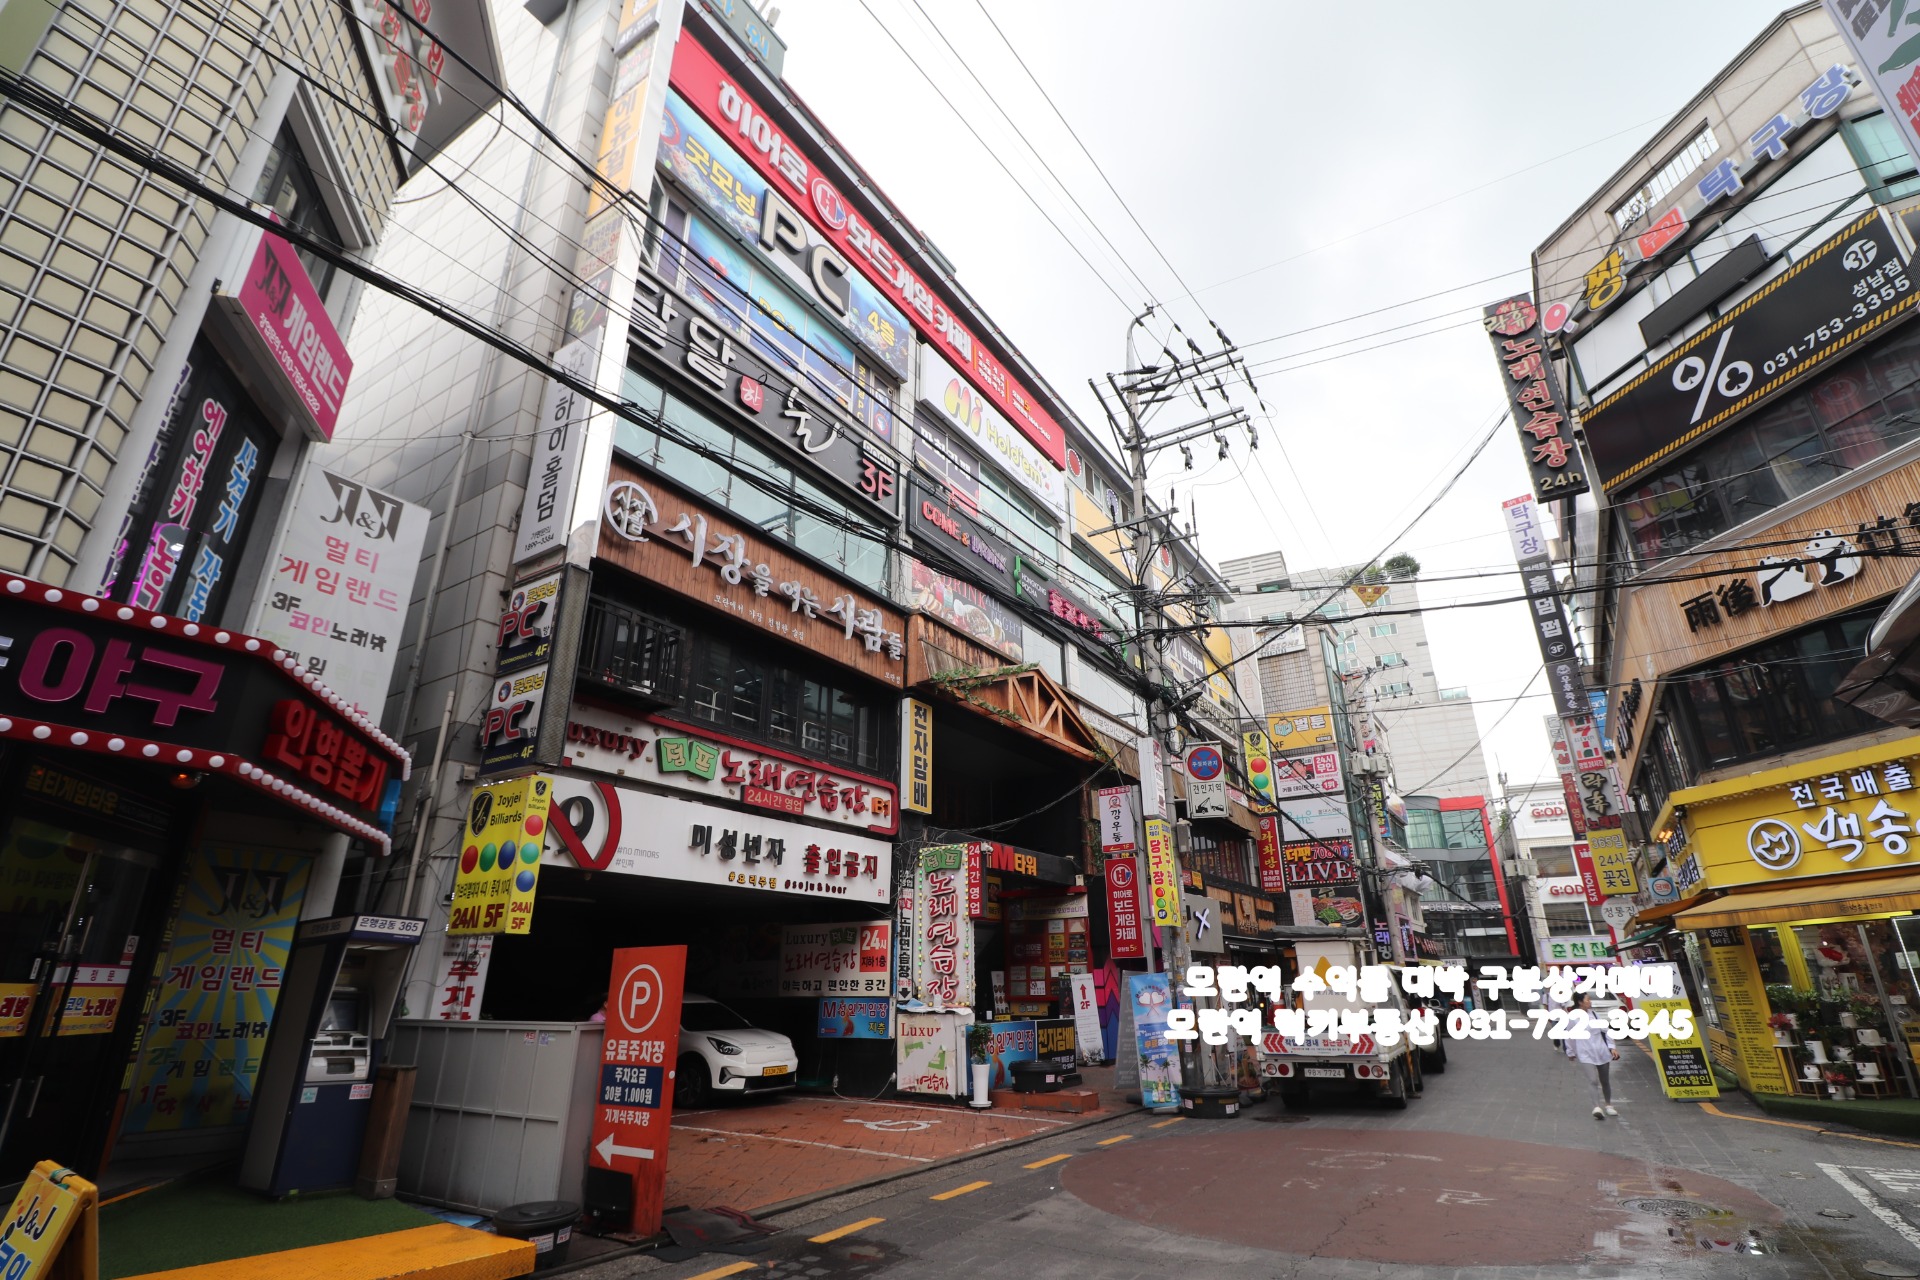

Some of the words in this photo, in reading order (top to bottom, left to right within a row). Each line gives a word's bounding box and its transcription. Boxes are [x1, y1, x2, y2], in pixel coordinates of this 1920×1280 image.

[1583, 248, 1628, 312] 짱
[1642, 213, 1687, 252] 무인
[1697, 63, 1853, 206] 탁구장
[719, 79, 808, 197] 히어로
[847, 213, 972, 364] 보드게임카페
[684, 135, 757, 216] 굿모닝
[758, 187, 850, 317] PC
[867, 310, 897, 348] 4층
[1843, 239, 1878, 272] 3F
[1851, 257, 1903, 299] 성남점
[1485, 300, 1537, 336] 락휴
[1763, 274, 1911, 376] 031-753-3355
[283, 292, 345, 415] 게임랜드
[1502, 337, 1573, 467] 노래연습장
[943, 377, 984, 437] Hi
[986, 418, 1043, 490] Hold'em
[168, 398, 228, 530] 에어하키
[212, 437, 258, 544] 사격기
[861, 458, 894, 500] 3F
[1539, 471, 1582, 491] 24h
[319, 470, 404, 543] J&J
[921, 501, 961, 541] COME
[1510, 504, 1540, 555] 탁구장
[324, 536, 380, 574] 멀티
[279, 556, 399, 613] 게임랜드
[526, 578, 559, 606] 굿모닝
[664, 512, 774, 597] 시장을
[779, 580, 821, 619] 여는
[825, 593, 904, 661] 사람들
[271, 592, 302, 613] 3F
[713, 594, 744, 614] 모란에서
[1529, 574, 1563, 639] 홀덤펍
[1680, 578, 1760, 634] 雨後
[496, 602, 548, 648] PC
[535, 642, 549, 657] 4F
[1550, 644, 1565, 655] 3F
[512, 670, 546, 697] 굿모닝
[482, 700, 535, 748] PC
[264, 702, 387, 812] 인형뽑기
[521, 745, 534, 759] 4F
[913, 704, 929, 808] 전자담배
[1274, 741, 1285, 749] 4F
[1192, 755, 1218, 768] 주정차금지
[1315, 754, 1333, 765] 24시
[1317, 763, 1336, 774] 무인
[722, 750, 871, 814] 노래연습장
[871, 796, 891, 818] B1
[1192, 783, 1223, 794] 견인지역
[1324, 781, 1335, 790] 1위
[1790, 763, 1916, 810] 전국매출
[497, 791, 521, 808] Joyjei
[747, 788, 782, 807] 24시간
[785, 796, 803, 813] 영업
[490, 811, 522, 828] Billiards
[1110, 809, 1123, 843] 깡우동
[1802, 799, 1920, 864] 백송
[690, 823, 786, 867] 미성년자
[804, 843, 879, 880] 출입금지
[1312, 844, 1341, 859] 7080
[1591, 834, 1624, 849] 365일
[1149, 839, 1164, 885] 당구장
[1290, 861, 1352, 882] LIVE
[1599, 853, 1625, 867] 24시
[728, 871, 777, 889] #요리주점
[1583, 872, 1598, 902] HOLLYS
[1602, 869, 1630, 888] 꽃집
[207, 866, 288, 918] J&J
[1113, 889, 1133, 899] 히어로
[483, 902, 505, 928] 5F
[1114, 900, 1134, 912] 보드
[360, 917, 398, 932] 은행공동
[398, 920, 419, 933] 365
[511, 917, 526, 930] 5F
[1115, 913, 1135, 926] 게임
[211, 928, 264, 955] 멀티
[785, 931, 828, 947] Luxury
[861, 929, 888, 951] 24시
[926, 873, 959, 1002] 노래연습장
[1116, 927, 1137, 940] 카페
[1374, 917, 1392, 960] 노래방
[1711, 928, 1729, 938] 365일
[784, 948, 857, 974] 노래연습장
[1551, 941, 1608, 958] 춘천집
[166, 964, 280, 993] 게임랜드
[782, 978, 823, 993] 아늑하고
[828, 978, 860, 993] 편안한
[865, 978, 886, 992] 공간
[85, 995, 117, 1017] 노래방
[630, 981, 651, 1019] P
[822, 1000, 888, 1020] M성인게임장
[1080, 1000, 1091, 1010] 2F
[1648, 1001, 1668, 1009] 나라를
[159, 1009, 186, 1027] 3F
[868, 1021, 886, 1034] 지층
[605, 1039, 665, 1064] 유료주차장
[1038, 1026, 1075, 1054] 전자담배
[615, 1066, 647, 1085] 주차요금
[1323, 1069, 1342, 1077] 7724
[1668, 1075, 1711, 1087] 30%할인
[605, 1085, 621, 1103] 30분
[624, 1087, 653, 1105] 1,000원
[605, 1108, 651, 1127] 기계식주차장
[16, 1196, 57, 1241] J&J
